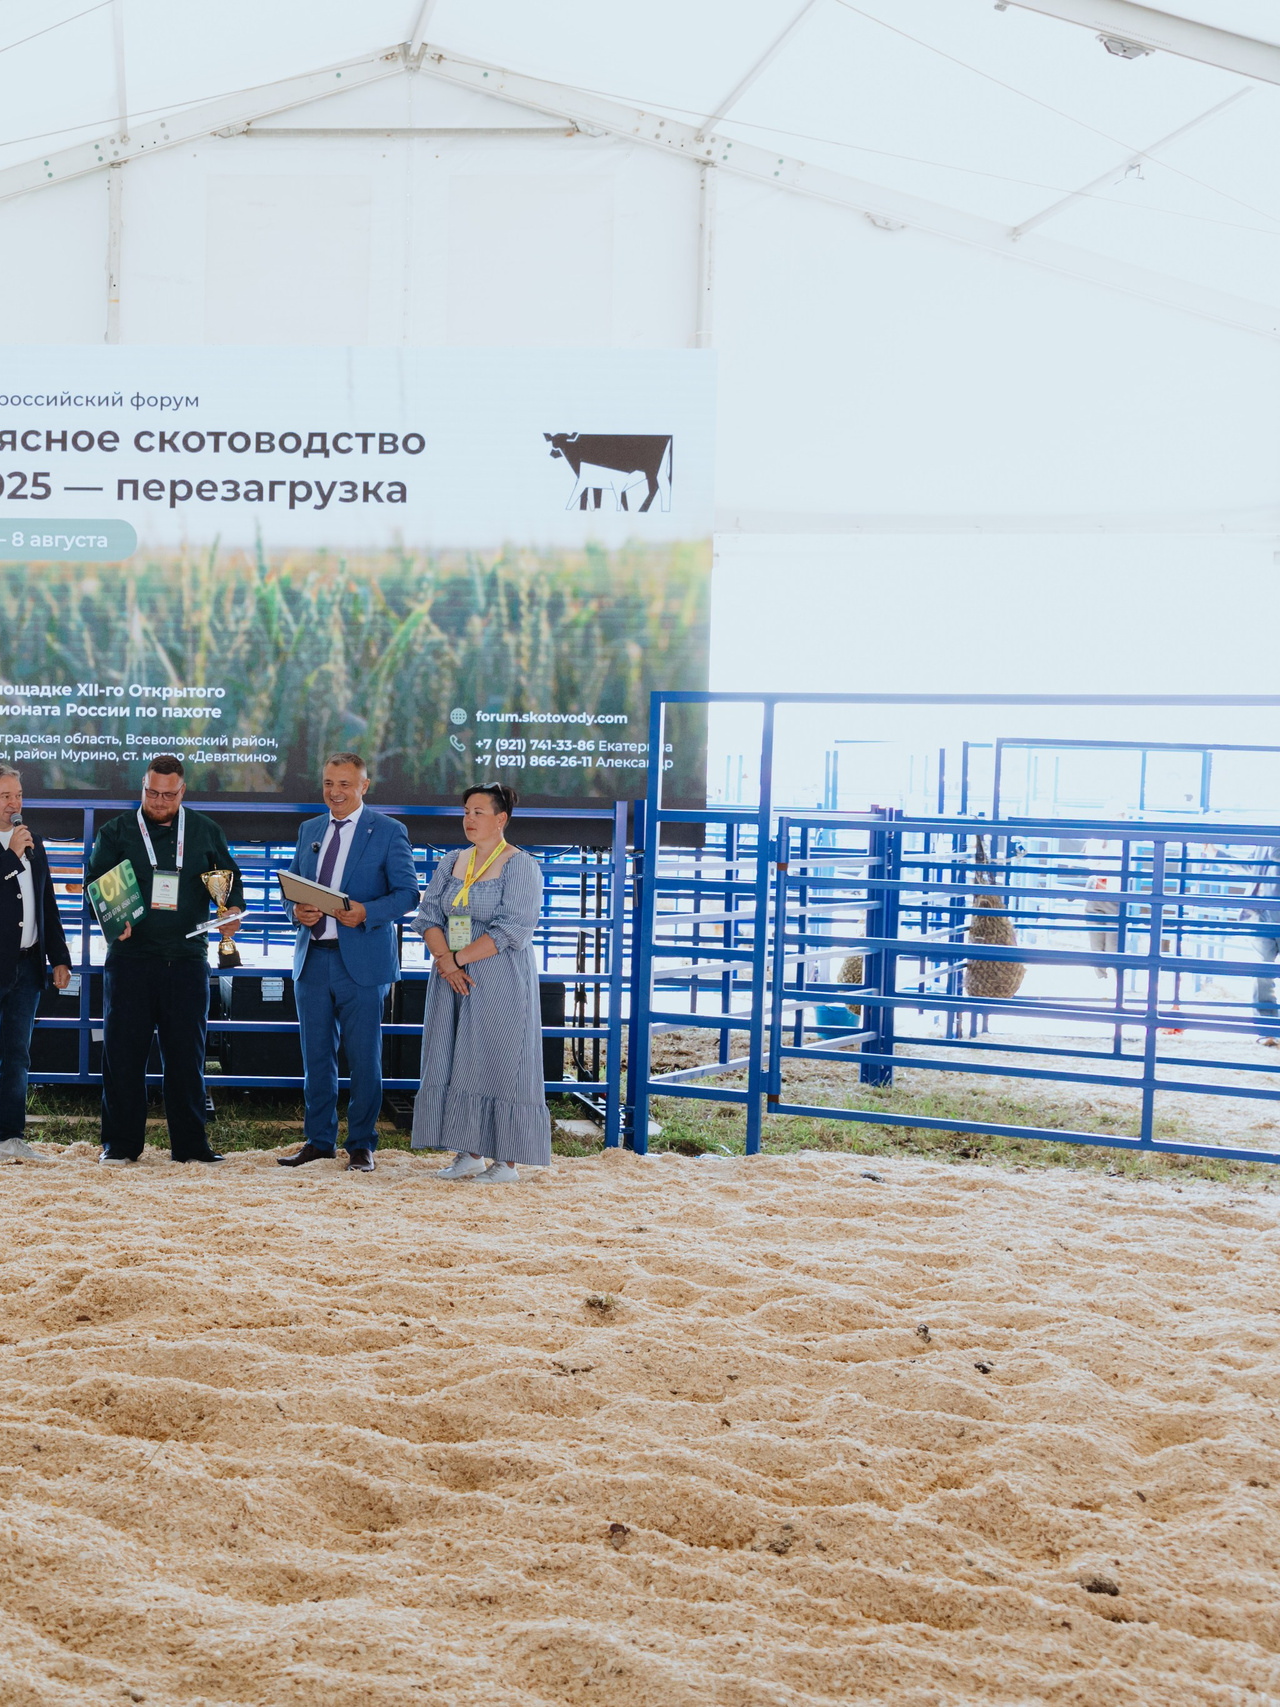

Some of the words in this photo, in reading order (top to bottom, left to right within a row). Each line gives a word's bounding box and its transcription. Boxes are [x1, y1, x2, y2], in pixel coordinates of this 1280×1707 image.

[130, 391, 199, 411] форум
[134, 430, 426, 458] скотоводство
[117, 479, 407, 510] перезагрузка
[11, 531, 24, 548] 8
[30, 535, 108, 551] августа
[76, 683, 125, 697] XII-го
[128, 684, 226, 700] Открытого
[65, 703, 131, 718] России
[135, 706, 158, 718] по
[162, 706, 222, 719] пахоте
[475, 710, 628, 726] forum.skotovody.com
[64, 732, 122, 746] область,
[125, 733, 229, 746] Всеволожский
[232, 735, 279, 748] район,
[475, 738, 492, 750] +7
[495, 738, 527, 752] (921)
[529, 739, 596, 752] 741-33-86
[598, 740, 673, 754] Екатера
[14, 748, 57, 761] район
[61, 749, 120, 762] Мурино,
[122, 751, 139, 761] ст.
[188, 750, 278, 763] «Девяткино»
[475, 754, 492, 766] +7
[495, 754, 526, 768] (921)
[529, 755, 592, 768] 866-26-11
[595, 756, 674, 770] Алексар
[88, 862, 137, 910] РСХБ
